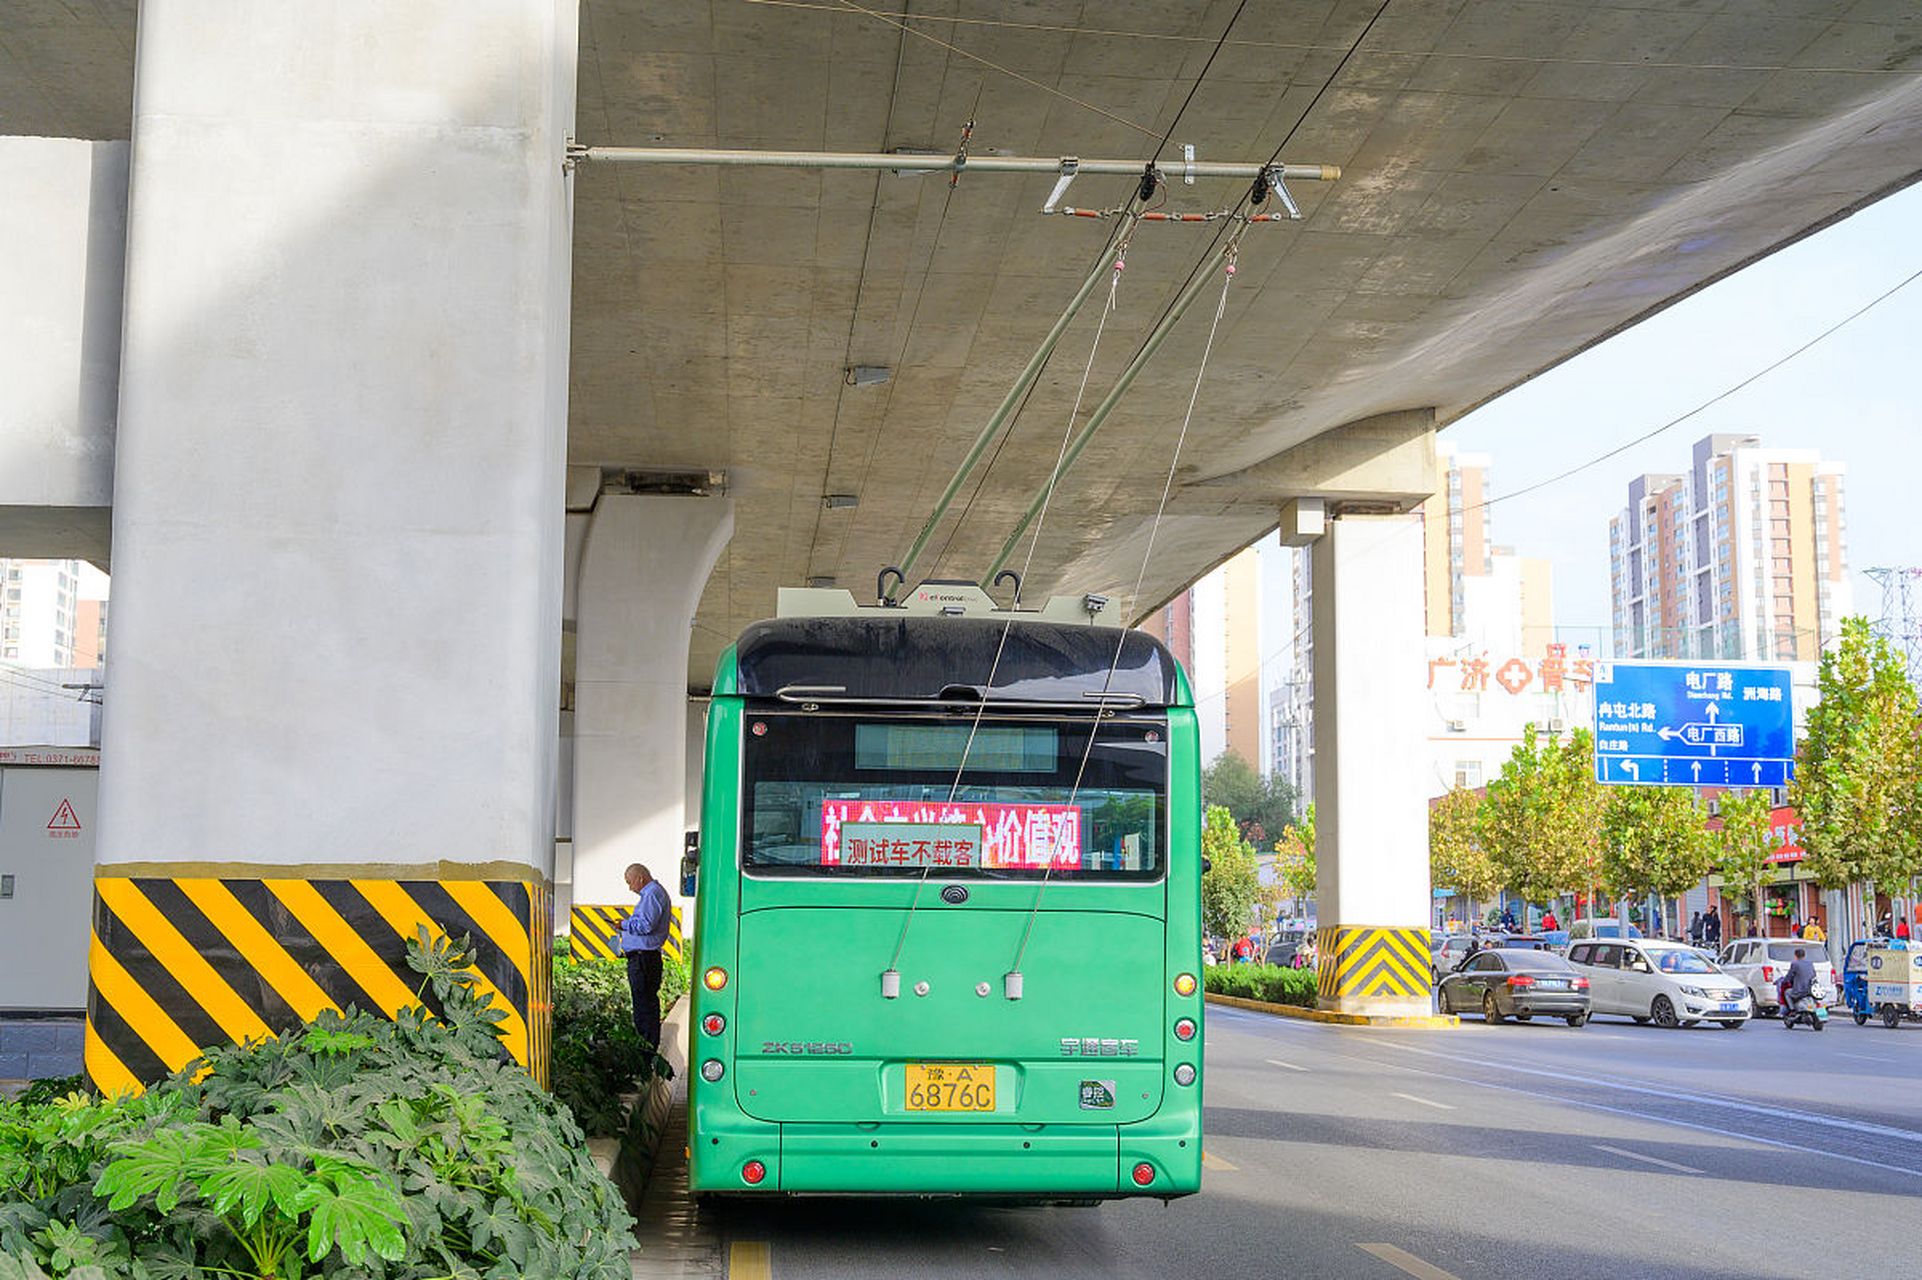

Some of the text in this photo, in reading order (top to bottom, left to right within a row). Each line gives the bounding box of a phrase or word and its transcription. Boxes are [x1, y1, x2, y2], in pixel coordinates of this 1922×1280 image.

[1427, 657, 1490, 691] 广济
[1686, 671, 1733, 691] 电厂路
[1598, 702, 1657, 720] 冉屯北路
[1687, 727, 1740, 743] 电厂西路
[848, 838, 974, 866] 测试车不载客
[911, 1084, 990, 1107] 6876C
